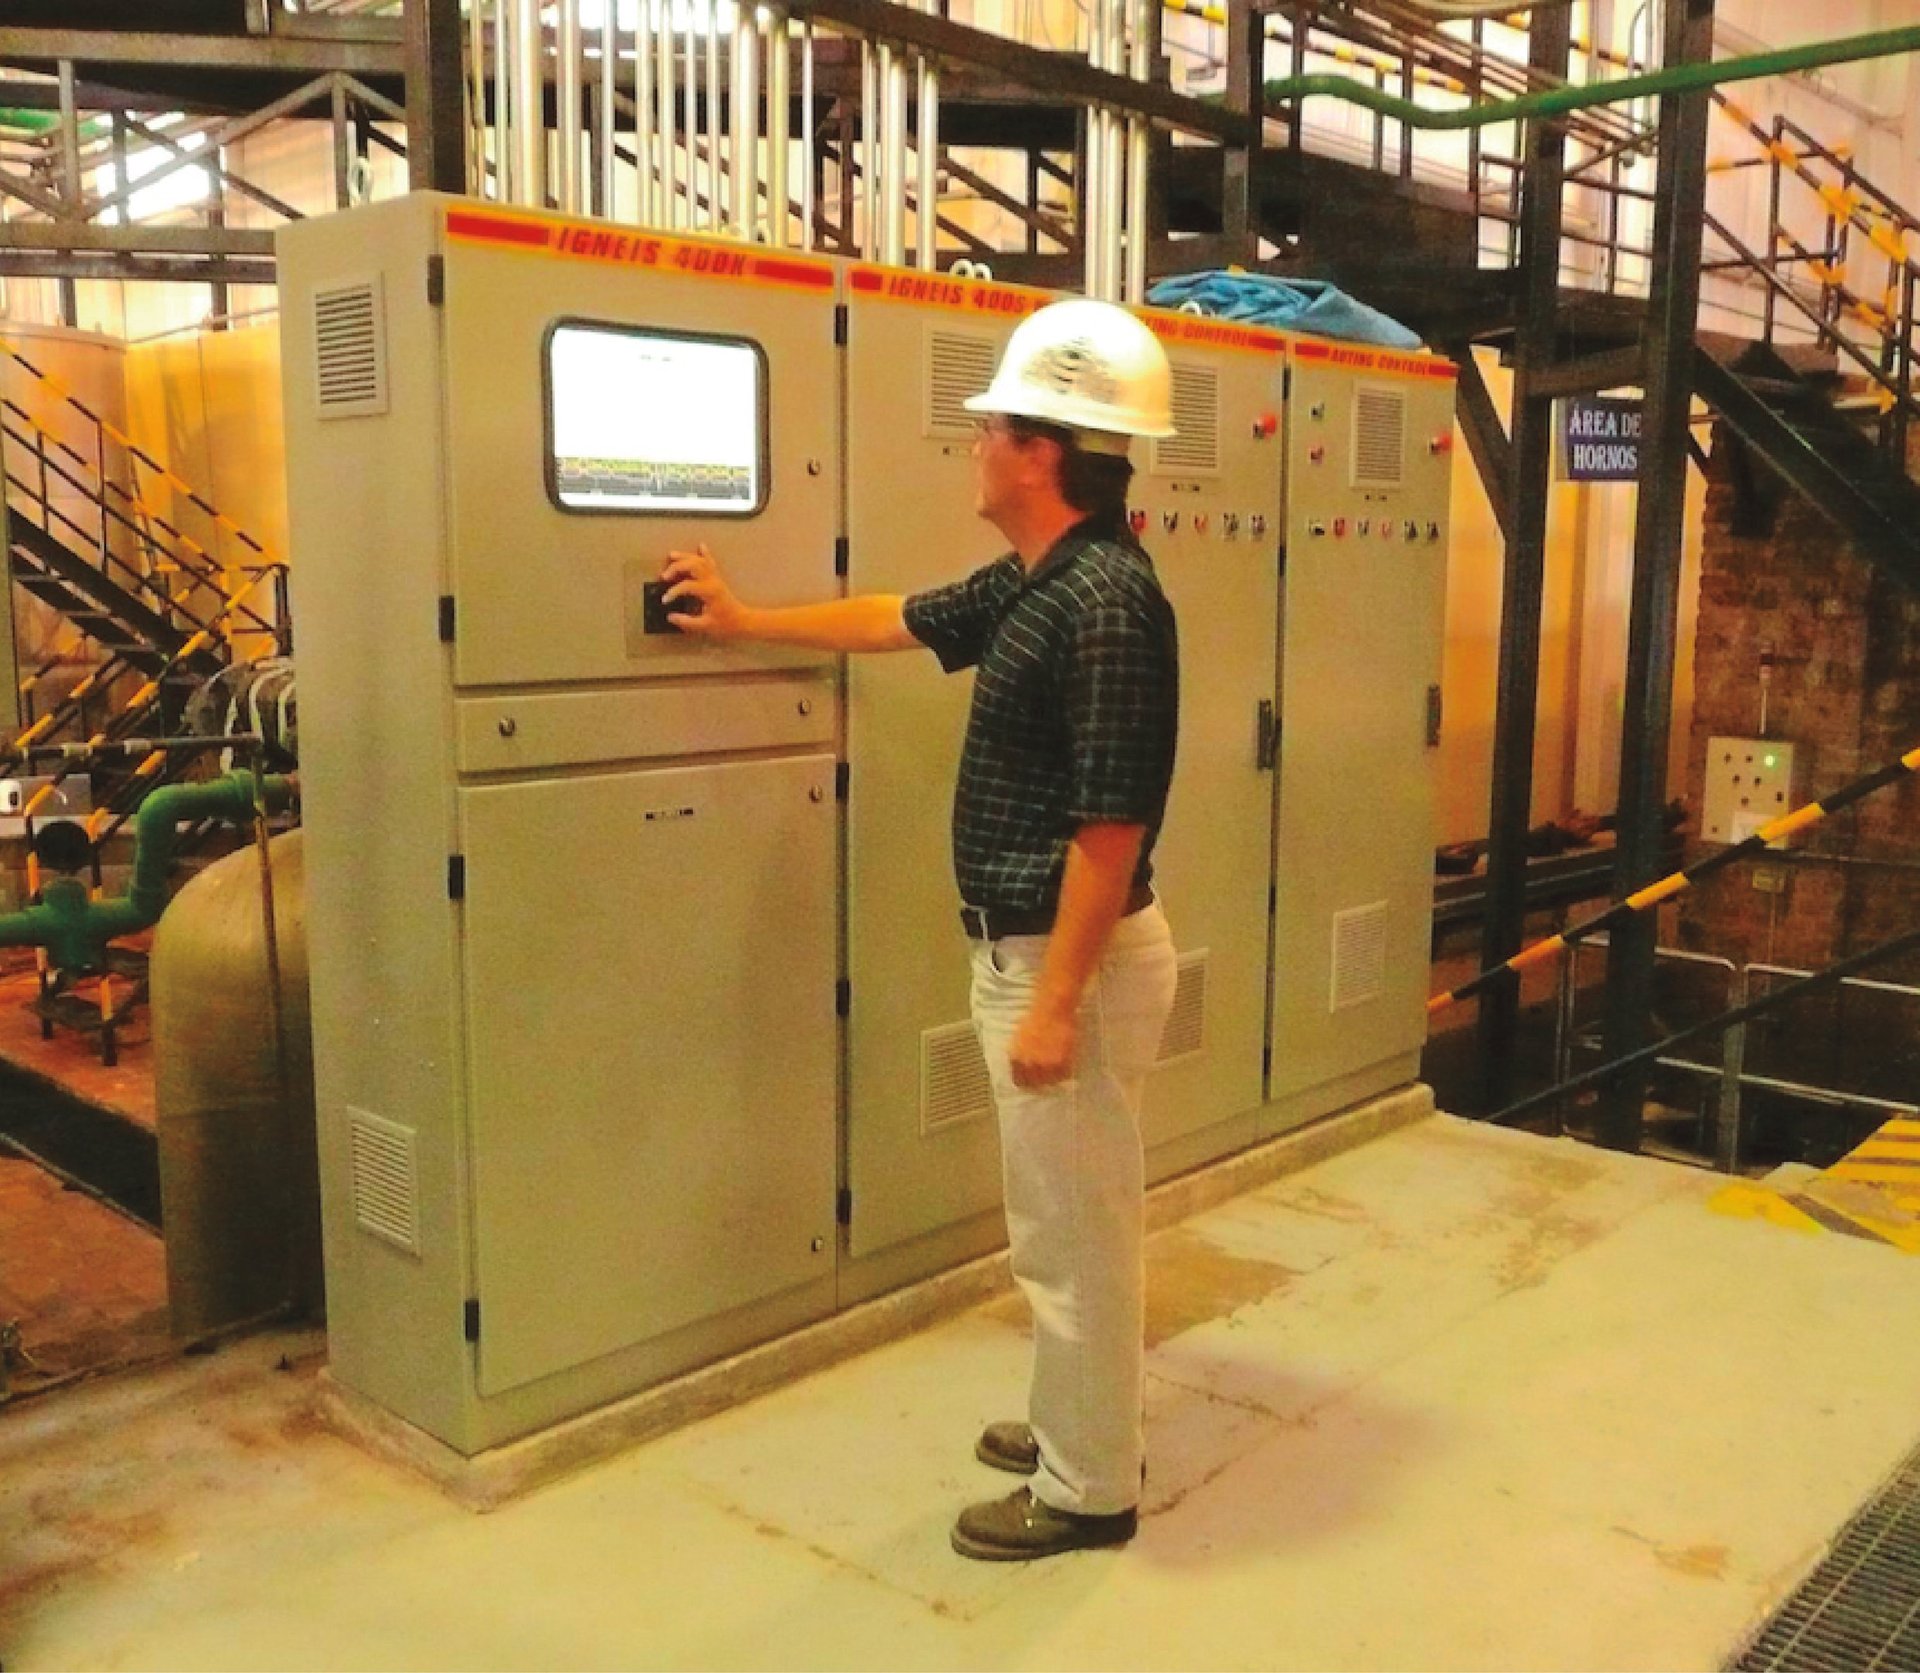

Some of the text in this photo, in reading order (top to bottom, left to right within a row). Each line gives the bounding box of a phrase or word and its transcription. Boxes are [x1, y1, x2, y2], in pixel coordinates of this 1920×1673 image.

[557, 226, 662, 265] IGNEIS
[888, 275, 965, 305] IGNEIS
[1569, 402, 1642, 438] ÁREA DE
[1573, 443, 1638, 471] HORNOS
